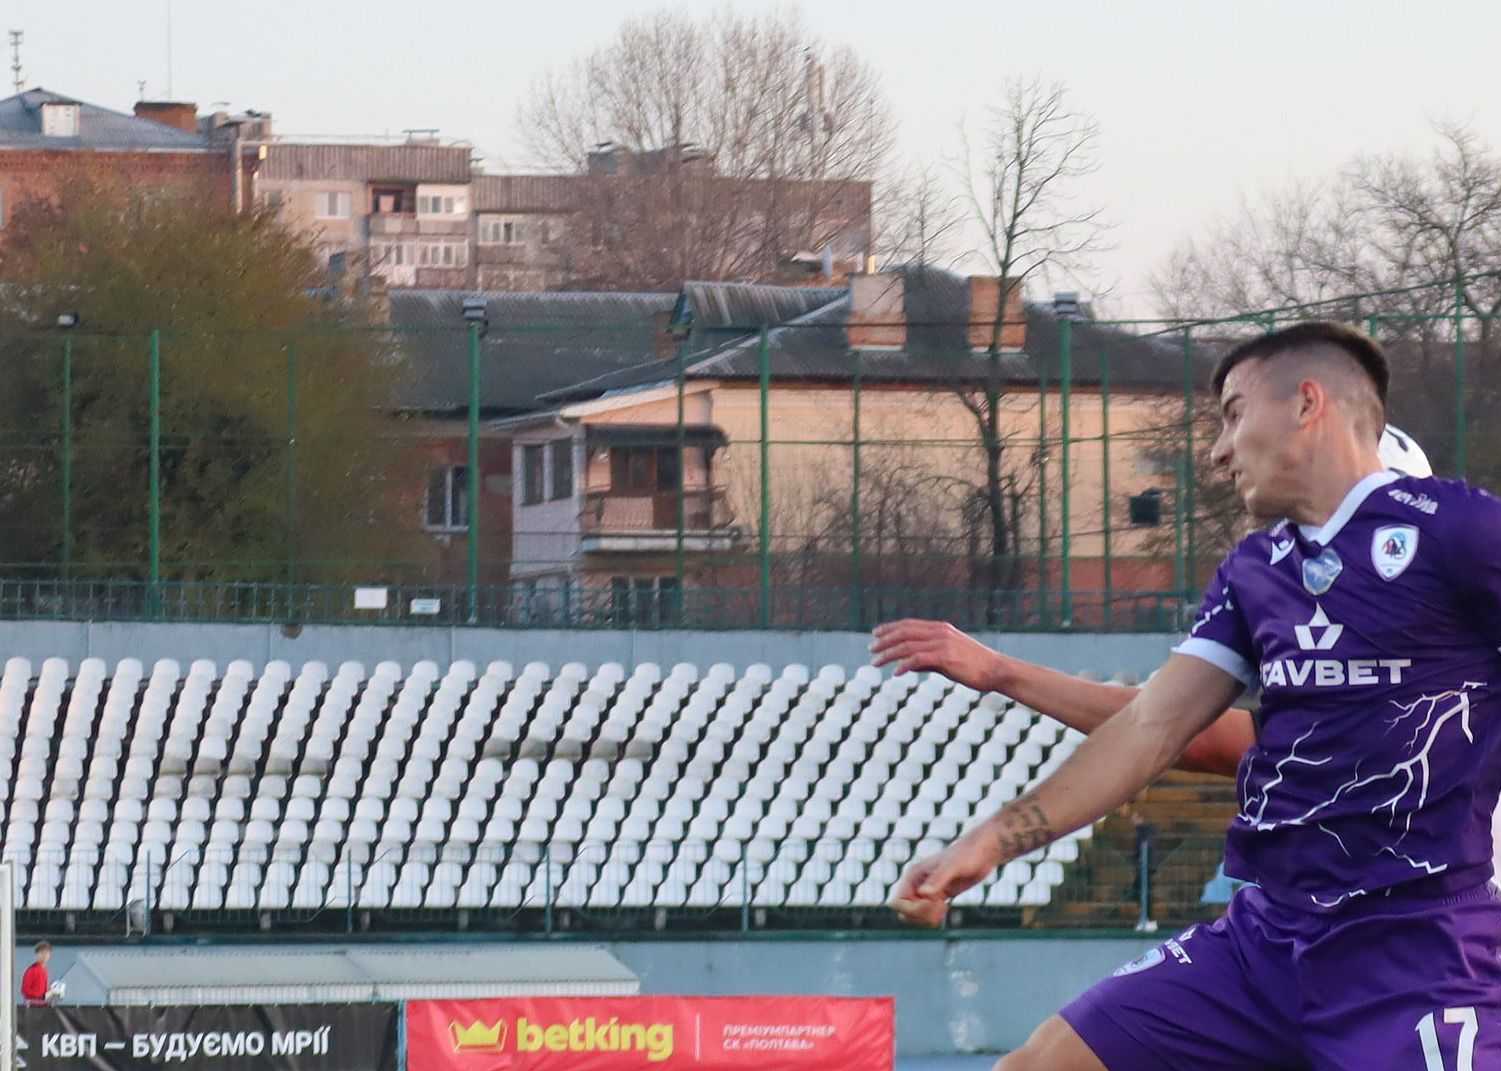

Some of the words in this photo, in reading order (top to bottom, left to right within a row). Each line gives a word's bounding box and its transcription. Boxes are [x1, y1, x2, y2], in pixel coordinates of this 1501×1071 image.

[41, 1034, 97, 1057] КВП
[132, 1033, 264, 1062] БУДУЄМО
[271, 1026, 331, 1055] МРІЇ
[516, 1016, 674, 1061] betking
